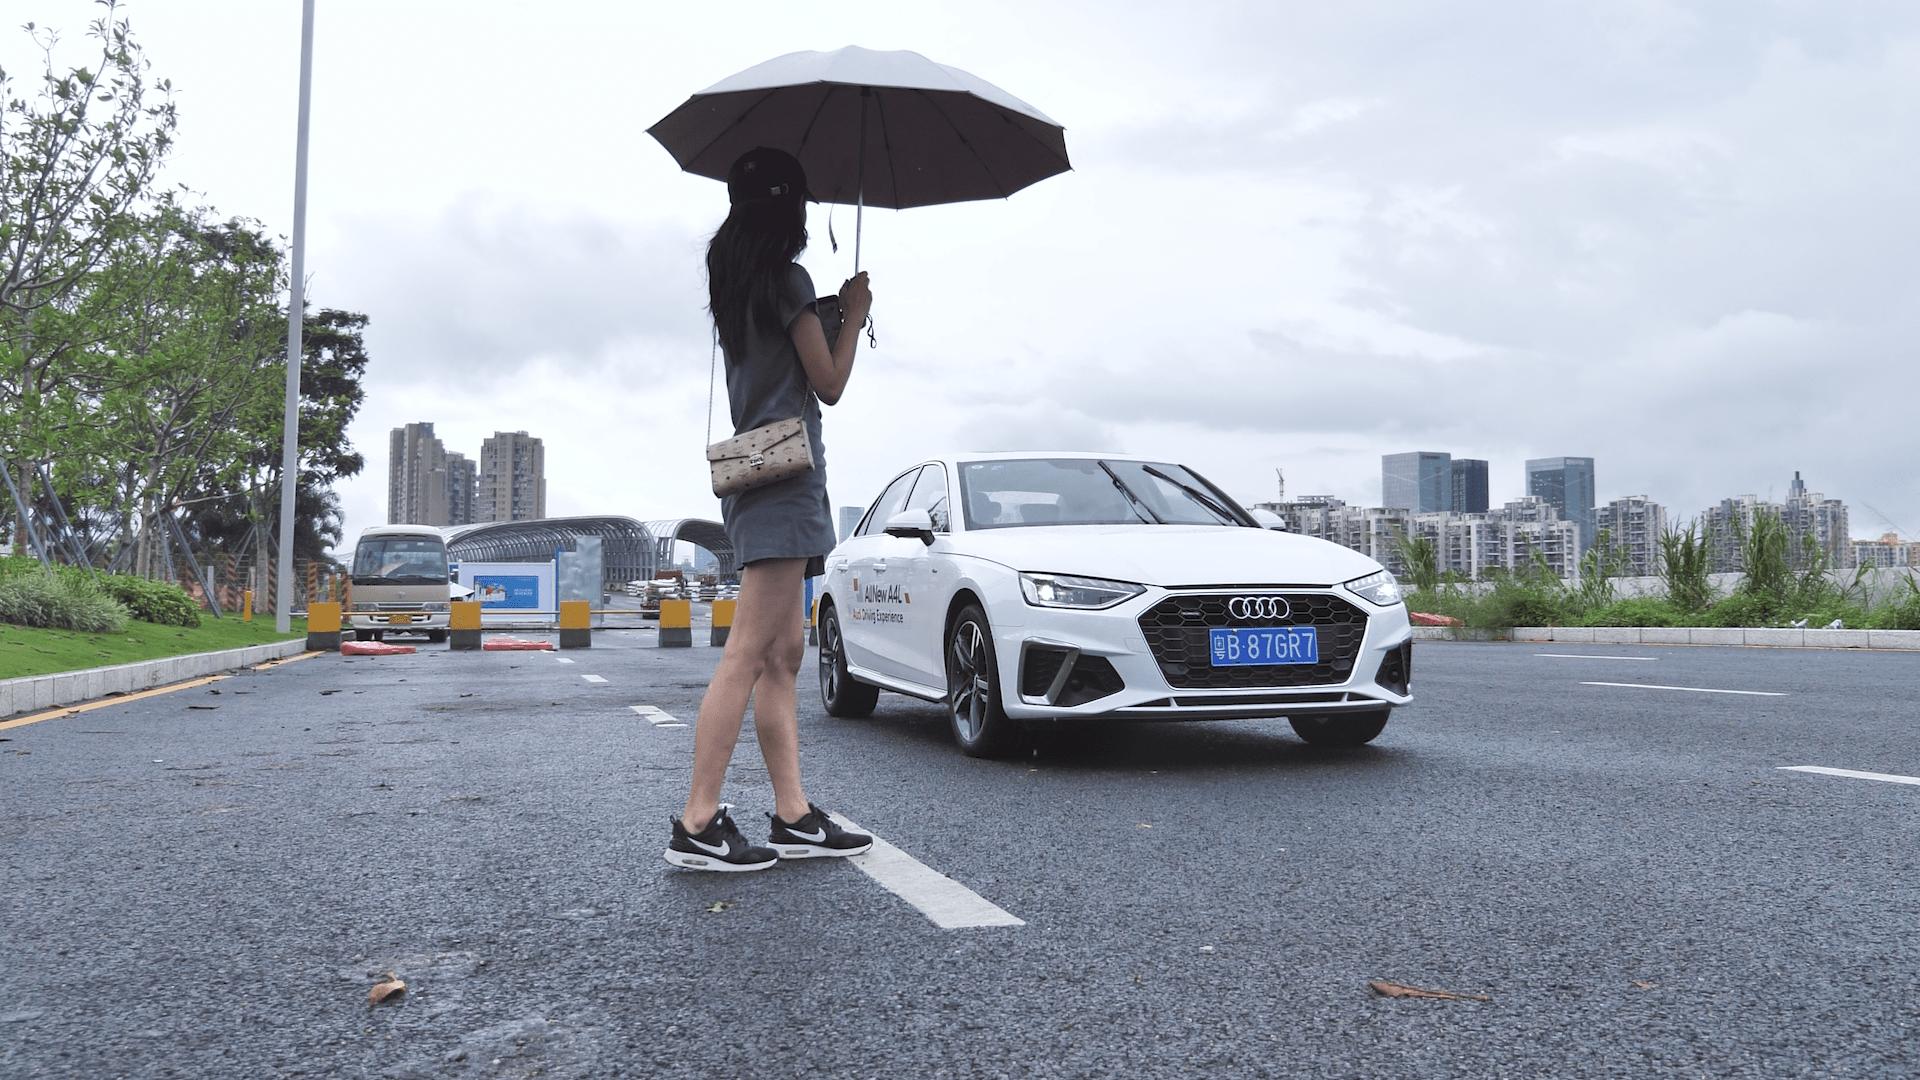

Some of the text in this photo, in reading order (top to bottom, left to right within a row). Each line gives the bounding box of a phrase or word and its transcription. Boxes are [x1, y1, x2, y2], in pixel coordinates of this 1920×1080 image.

[888, 584, 902, 603] A4L
[862, 608, 876, 624] Driving
[876, 609, 904, 624] Experience
